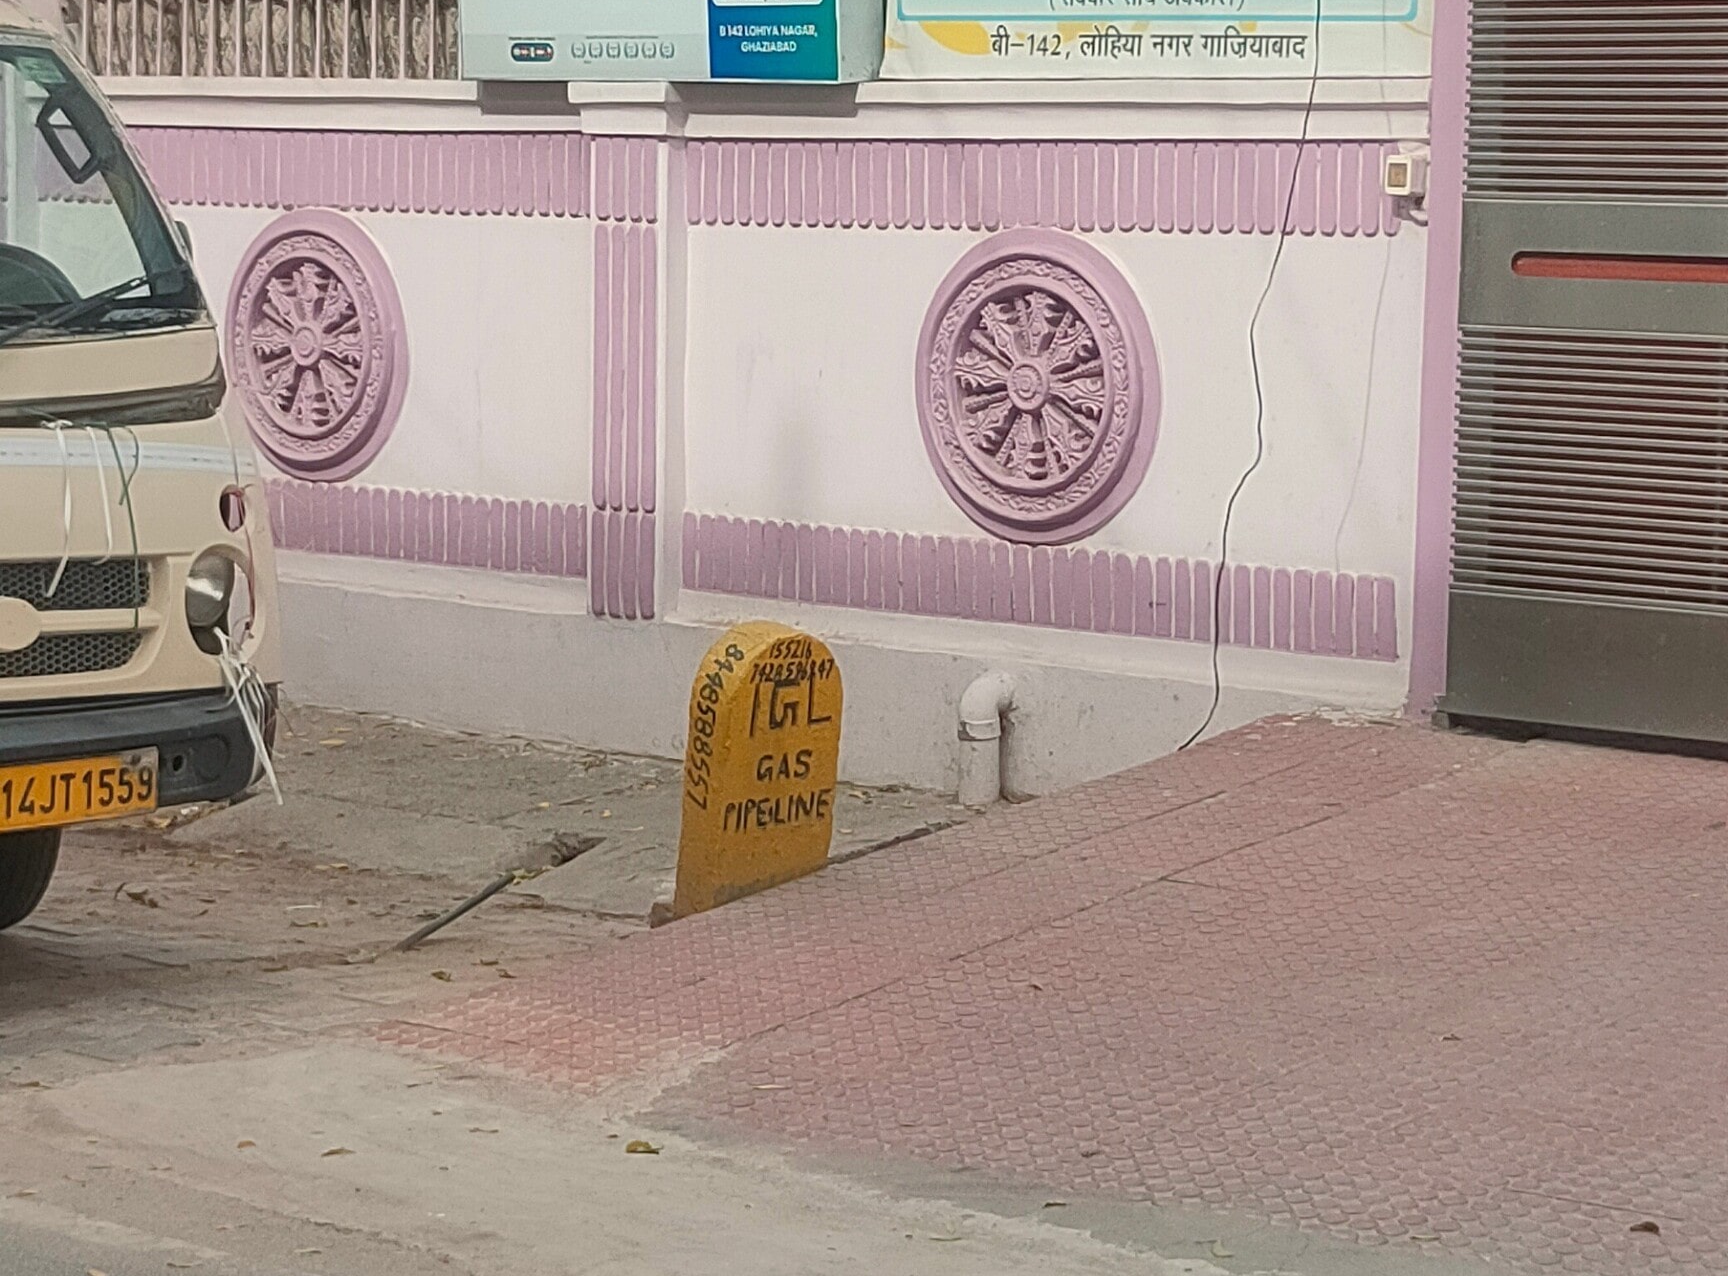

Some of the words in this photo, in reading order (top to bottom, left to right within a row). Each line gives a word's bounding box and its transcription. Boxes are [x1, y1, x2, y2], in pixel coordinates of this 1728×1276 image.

[740, 40, 797, 53] GHAZIABAD
[744, 25, 779, 37] LOHIYA
[1078, 25, 1144, 60] लोहिया
[1149, 34, 1194, 59] नगर
[749, 675, 833, 738] IGL
[756, 748, 813, 782] GAS
[2, 765, 154, 820] 14JT1559
[723, 788, 833, 834] PIPELINE
